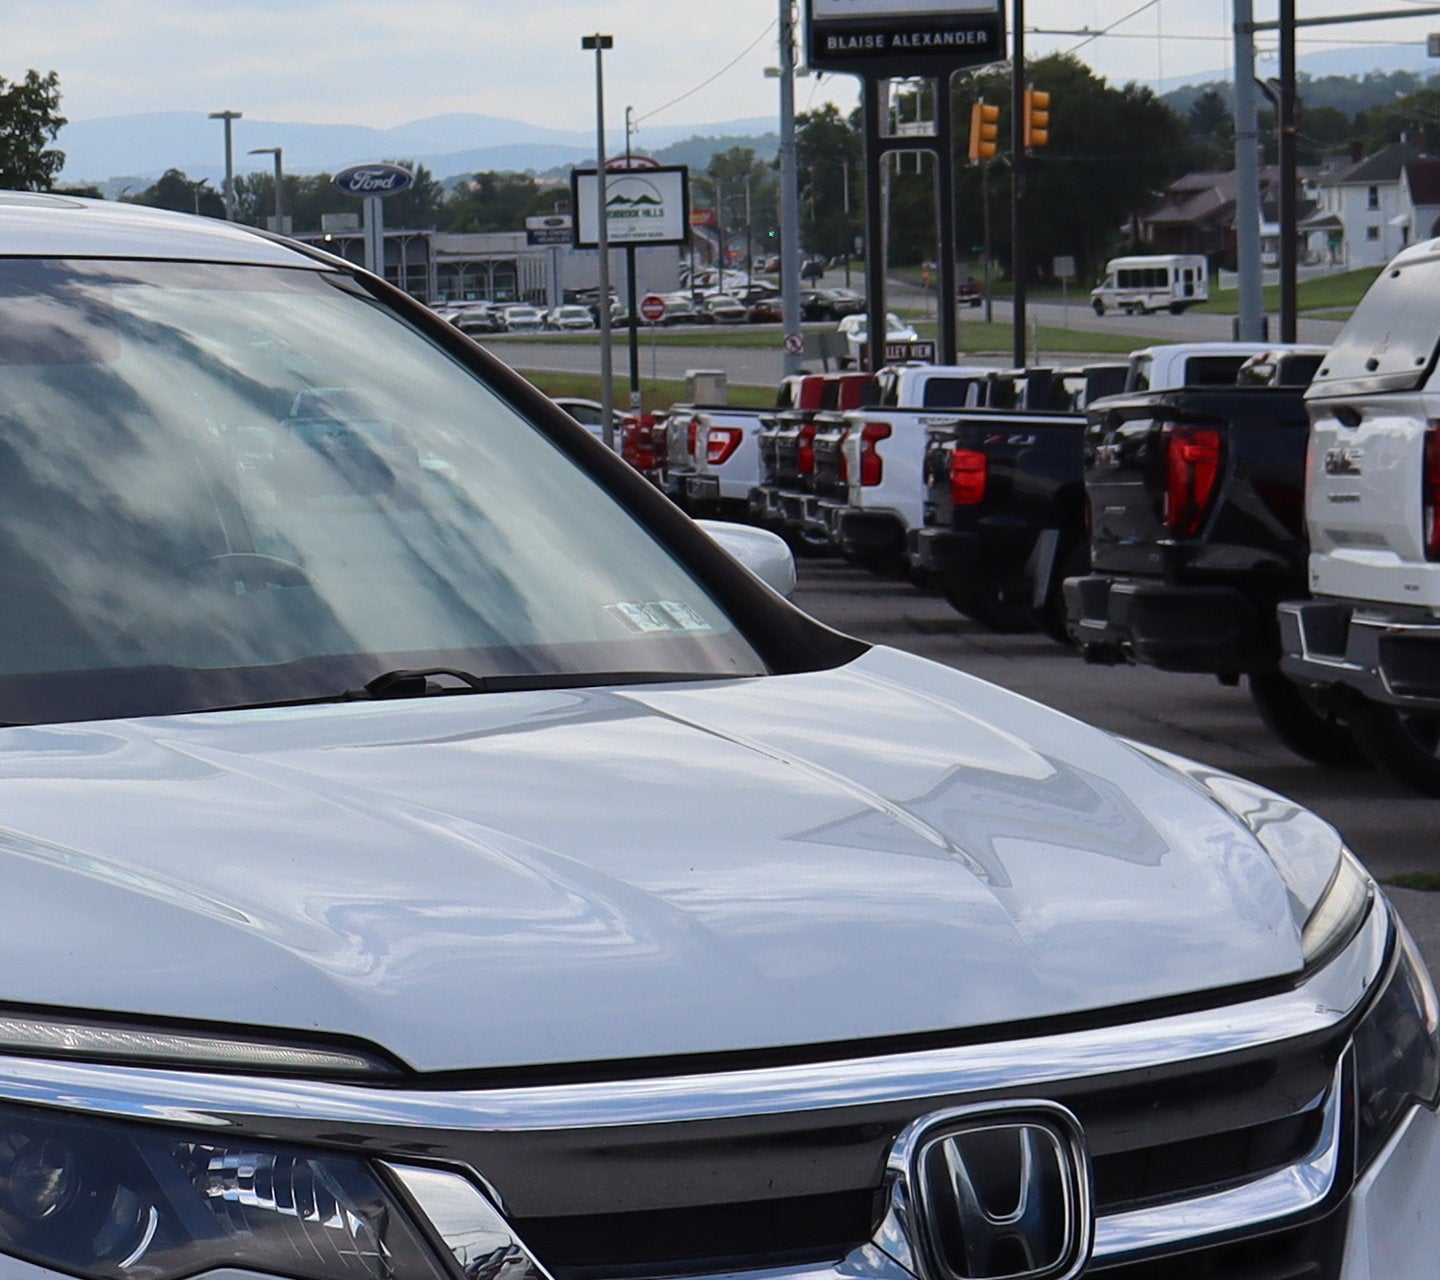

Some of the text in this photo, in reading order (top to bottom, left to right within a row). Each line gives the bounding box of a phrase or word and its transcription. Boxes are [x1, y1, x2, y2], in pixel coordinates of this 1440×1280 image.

[827, 30, 988, 49] BLAISE ALEXANDER
[349, 169, 397, 190] Ford
